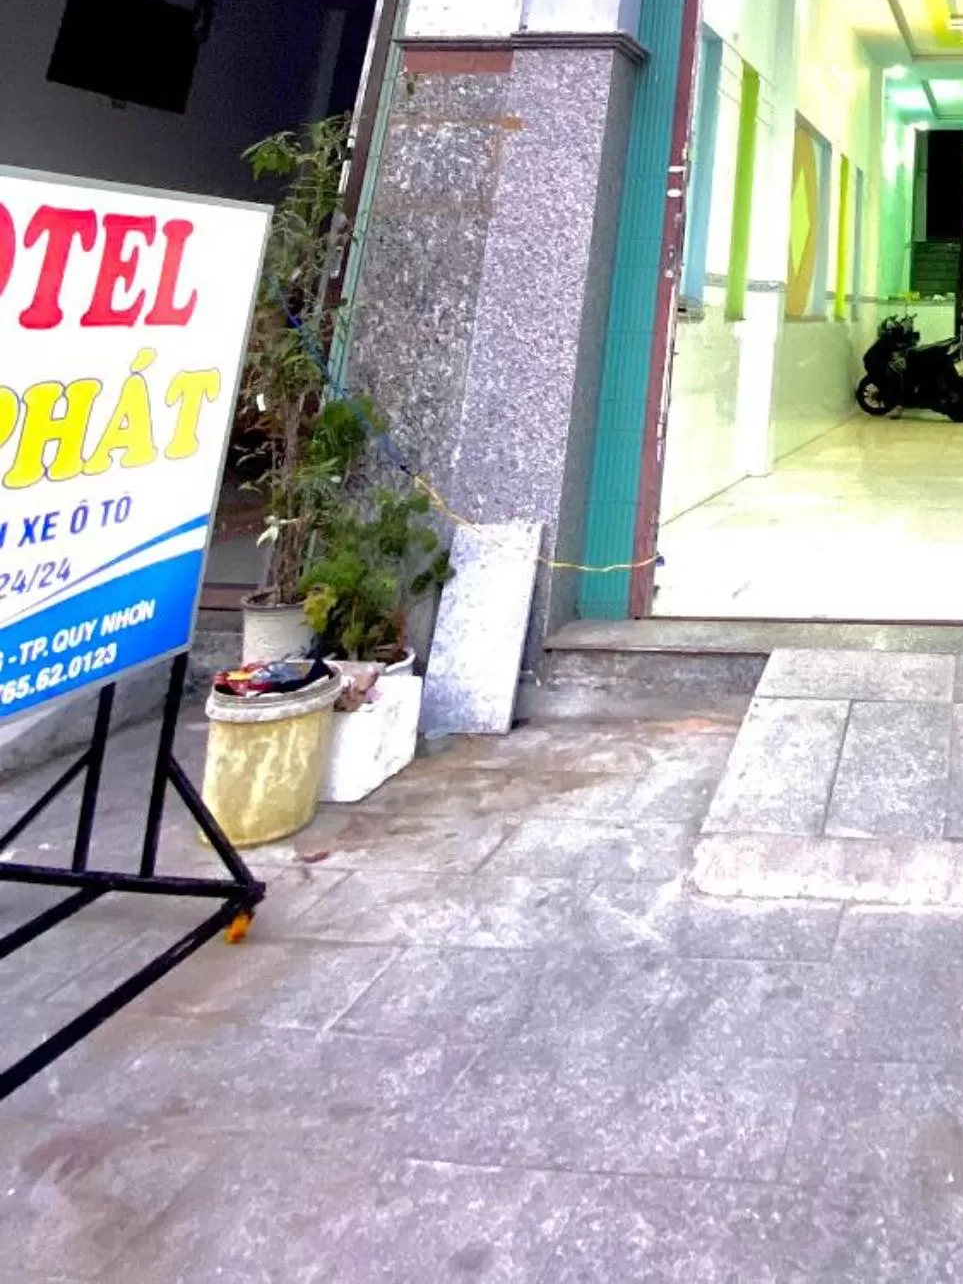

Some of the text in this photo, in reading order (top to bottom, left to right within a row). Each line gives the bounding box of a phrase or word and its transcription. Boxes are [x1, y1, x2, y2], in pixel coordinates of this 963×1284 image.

[0, 201, 198, 330] TEL
[17, 511, 61, 548] XE
[69, 499, 90, 535] Ô
[100, 491, 133, 528] TÔ
[52, 619, 98, 653] QUY
[100, 599, 157, 637] NHƠN
